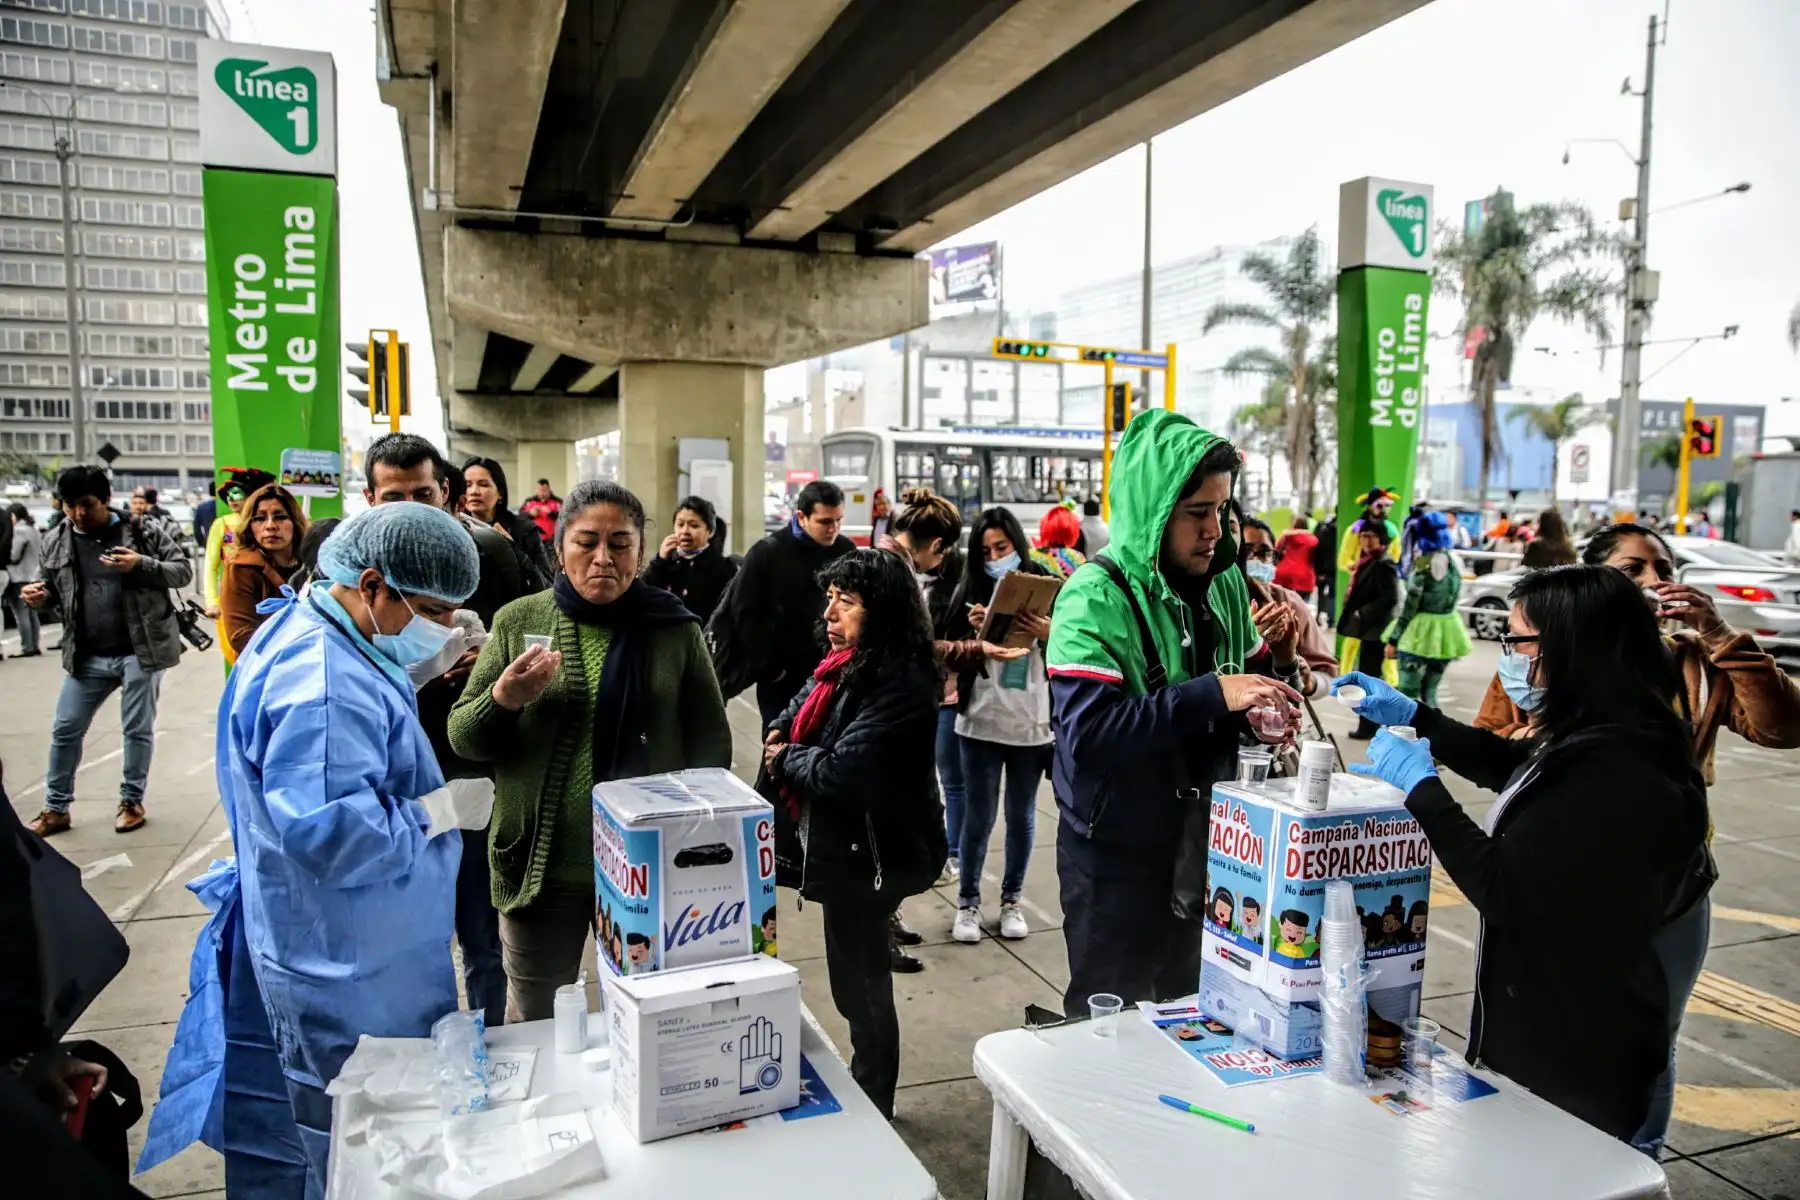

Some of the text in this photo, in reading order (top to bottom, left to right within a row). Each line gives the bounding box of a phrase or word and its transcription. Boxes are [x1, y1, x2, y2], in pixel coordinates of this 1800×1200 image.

[235, 63, 309, 103] línea
[287, 106, 310, 147] 1
[1409, 223, 1424, 252] 1
[273, 206, 318, 393] de Lima
[226, 253, 269, 391] Metro
[1396, 293, 1423, 429] de Lima
[1369, 327, 1396, 427] Metro
[1233, 805, 1248, 826] de
[1289, 820, 1360, 849] Campaña
[1240, 866, 1262, 883] familia
[1285, 884, 1297, 895] No
[664, 899, 746, 953] Vida
[720, 1040, 733, 1054] CE
[1295, 1036, 1312, 1050] 20
[704, 1077, 719, 1089] 50
